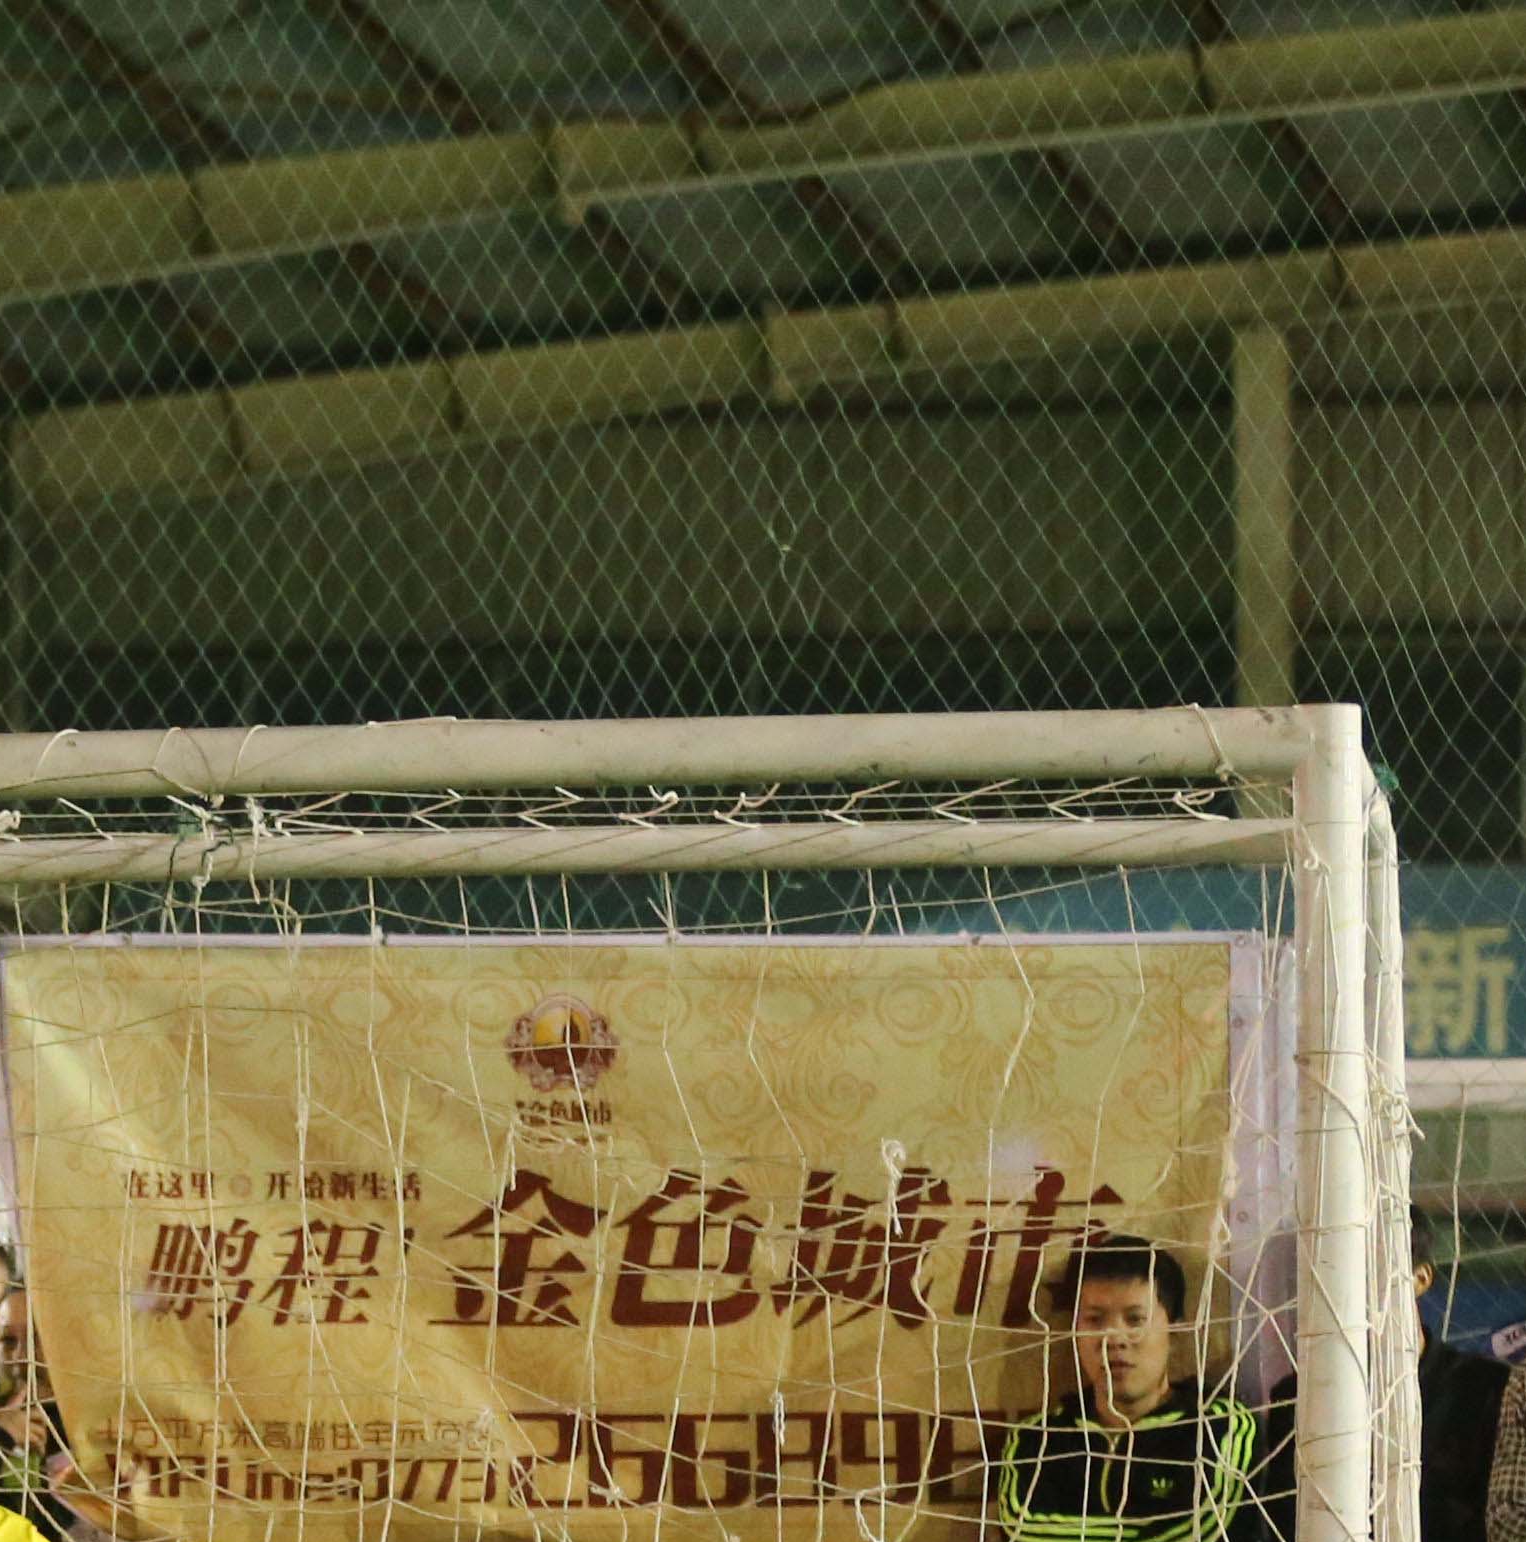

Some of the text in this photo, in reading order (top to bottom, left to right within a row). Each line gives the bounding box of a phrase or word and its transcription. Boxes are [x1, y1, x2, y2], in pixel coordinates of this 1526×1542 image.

[123, 1168, 422, 1201] 在这里 开始新生活
[508, 1411, 1046, 1507] 266898
